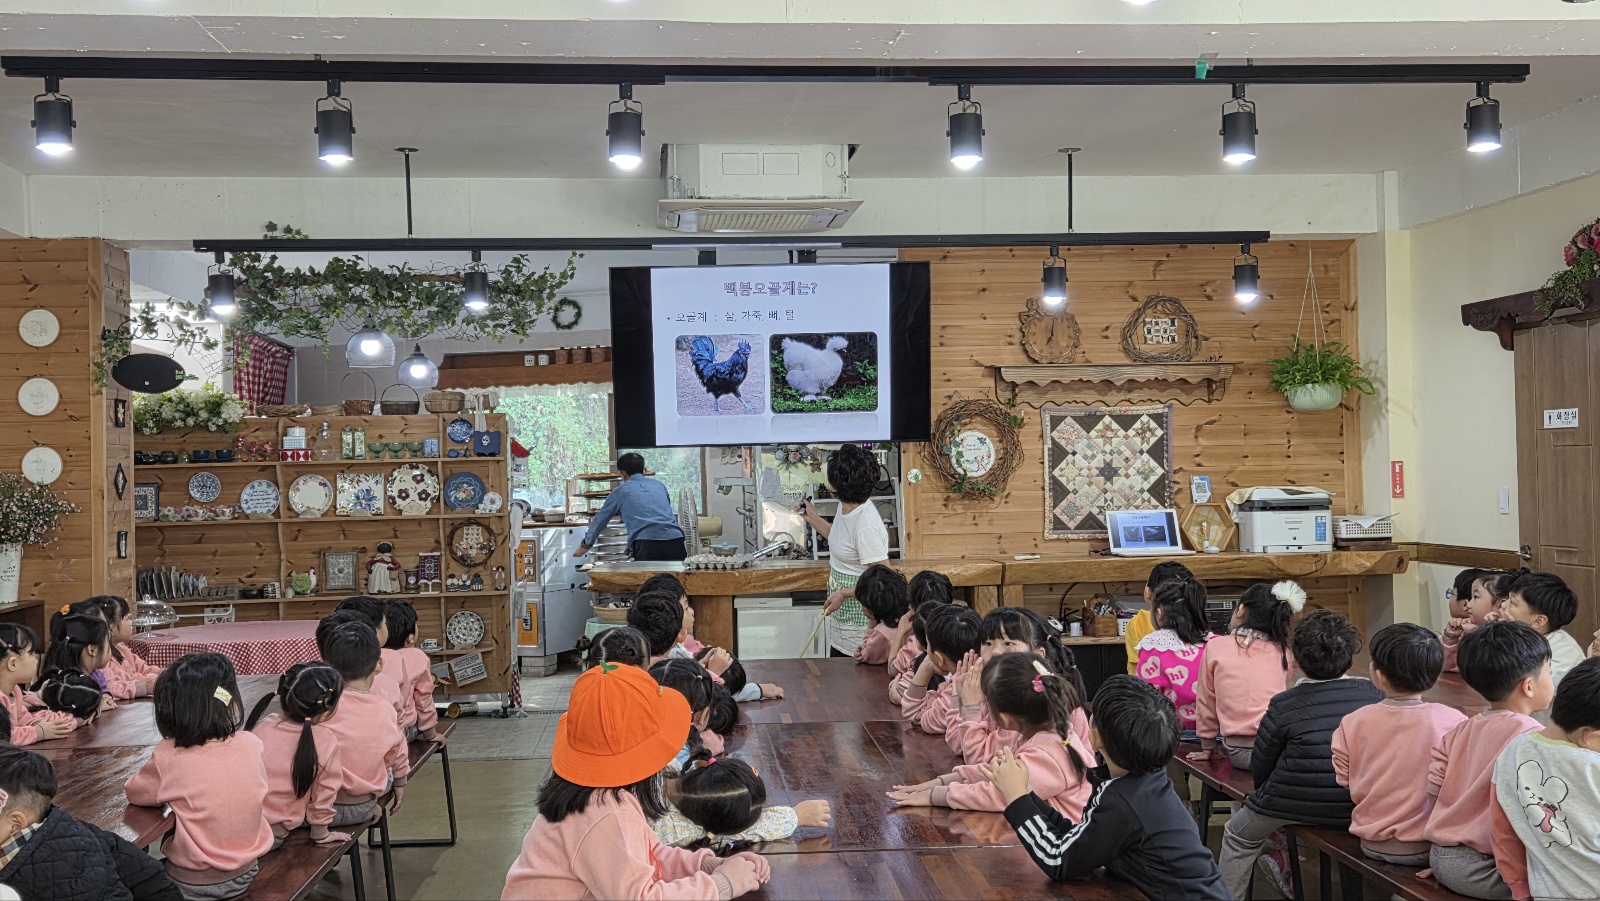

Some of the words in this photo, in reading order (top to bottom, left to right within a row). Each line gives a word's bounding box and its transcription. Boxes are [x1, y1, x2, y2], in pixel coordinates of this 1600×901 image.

[675, 311, 707, 323] 오골계
[785, 309, 795, 321] 털
[1180, 647, 1196, 657] hi
[1144, 661, 1159, 676] hi
[1169, 670, 1184, 681] hi
